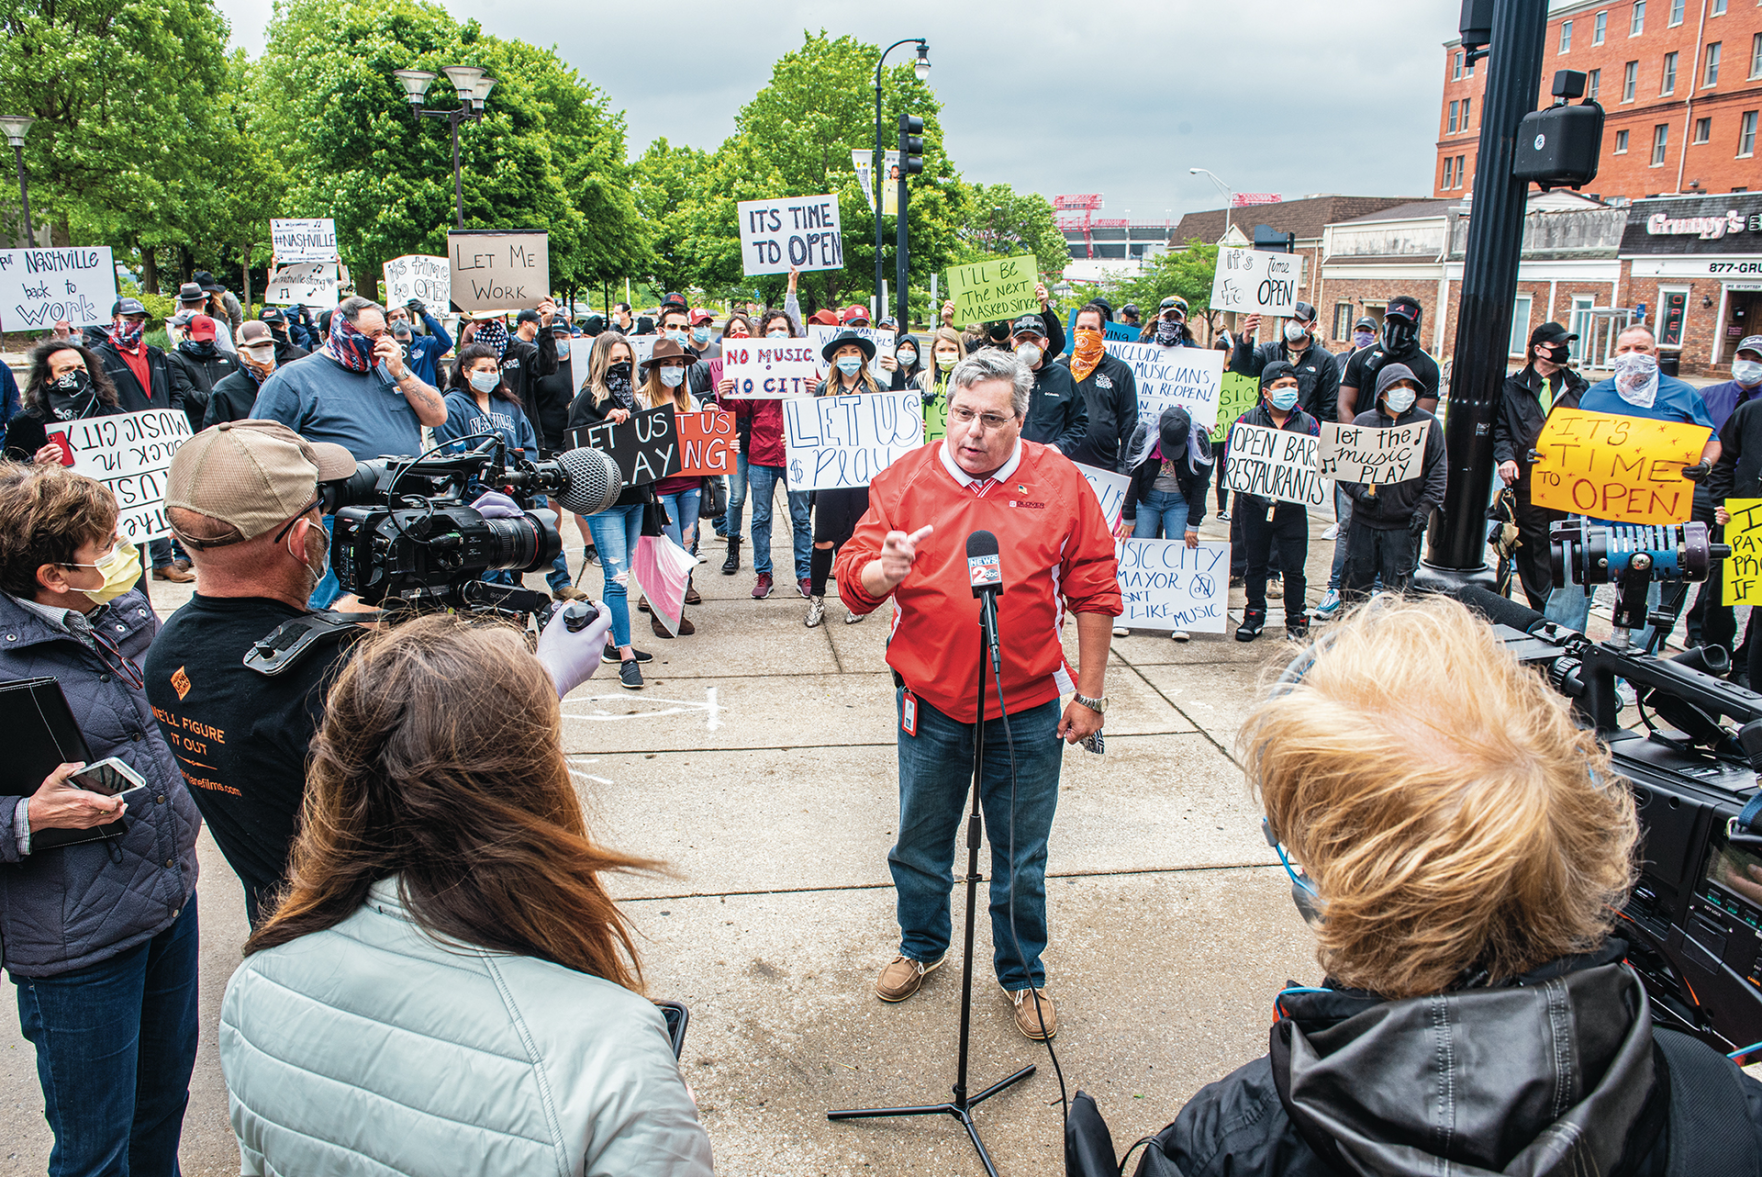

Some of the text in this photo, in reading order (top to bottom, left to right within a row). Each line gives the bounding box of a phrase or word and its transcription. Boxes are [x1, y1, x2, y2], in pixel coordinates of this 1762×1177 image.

[749, 203, 834, 234] IT'S TIME
[1646, 209, 1746, 240] Grumpy's
[274, 233, 336, 247] #NASHVILLE
[752, 231, 842, 267] TO OPEN
[411, 255, 449, 281] time
[456, 244, 535, 271] LET ME
[22, 279, 77, 300] back to
[414, 278, 450, 302] OPEN
[471, 278, 526, 300] WORK
[1257, 278, 1295, 307] OPEN
[1667, 295, 1684, 344] OPEN
[726, 348, 749, 366] NO
[1109, 343, 1166, 363] INCLUDE
[763, 377, 809, 394] CIT
[1134, 362, 1210, 385] MUSICIANS
[1141, 381, 1216, 402] IN REOPEN!
[66, 412, 190, 453] MUSIC CITY
[634, 412, 668, 443] US
[701, 412, 731, 435] US
[786, 394, 861, 449] LET
[871, 394, 922, 448] US
[1555, 417, 1631, 446] IT'S
[1233, 426, 1278, 459] OPEN
[1335, 426, 1411, 449] let the
[630, 443, 674, 486] AY
[684, 438, 728, 471] NG
[1335, 446, 1412, 466] music
[1550, 443, 1691, 483] TIME
[1222, 457, 1325, 505] RESTAURANTS
[1359, 460, 1410, 485] PLAY
[1536, 470, 1560, 487] TO
[1572, 478, 1680, 517] OPEN
[970, 556, 998, 567] NEWS
[1162, 543, 1224, 572] CITY
[972, 566, 989, 584] 2
[1116, 570, 1183, 590] MAYOR
[1122, 590, 1151, 603] SN'T
[1731, 578, 1756, 602] IF
[1130, 602, 1222, 628] LIKE MUSIC
[182, 716, 226, 745] FIGURE
[170, 732, 208, 756] IT OUT
